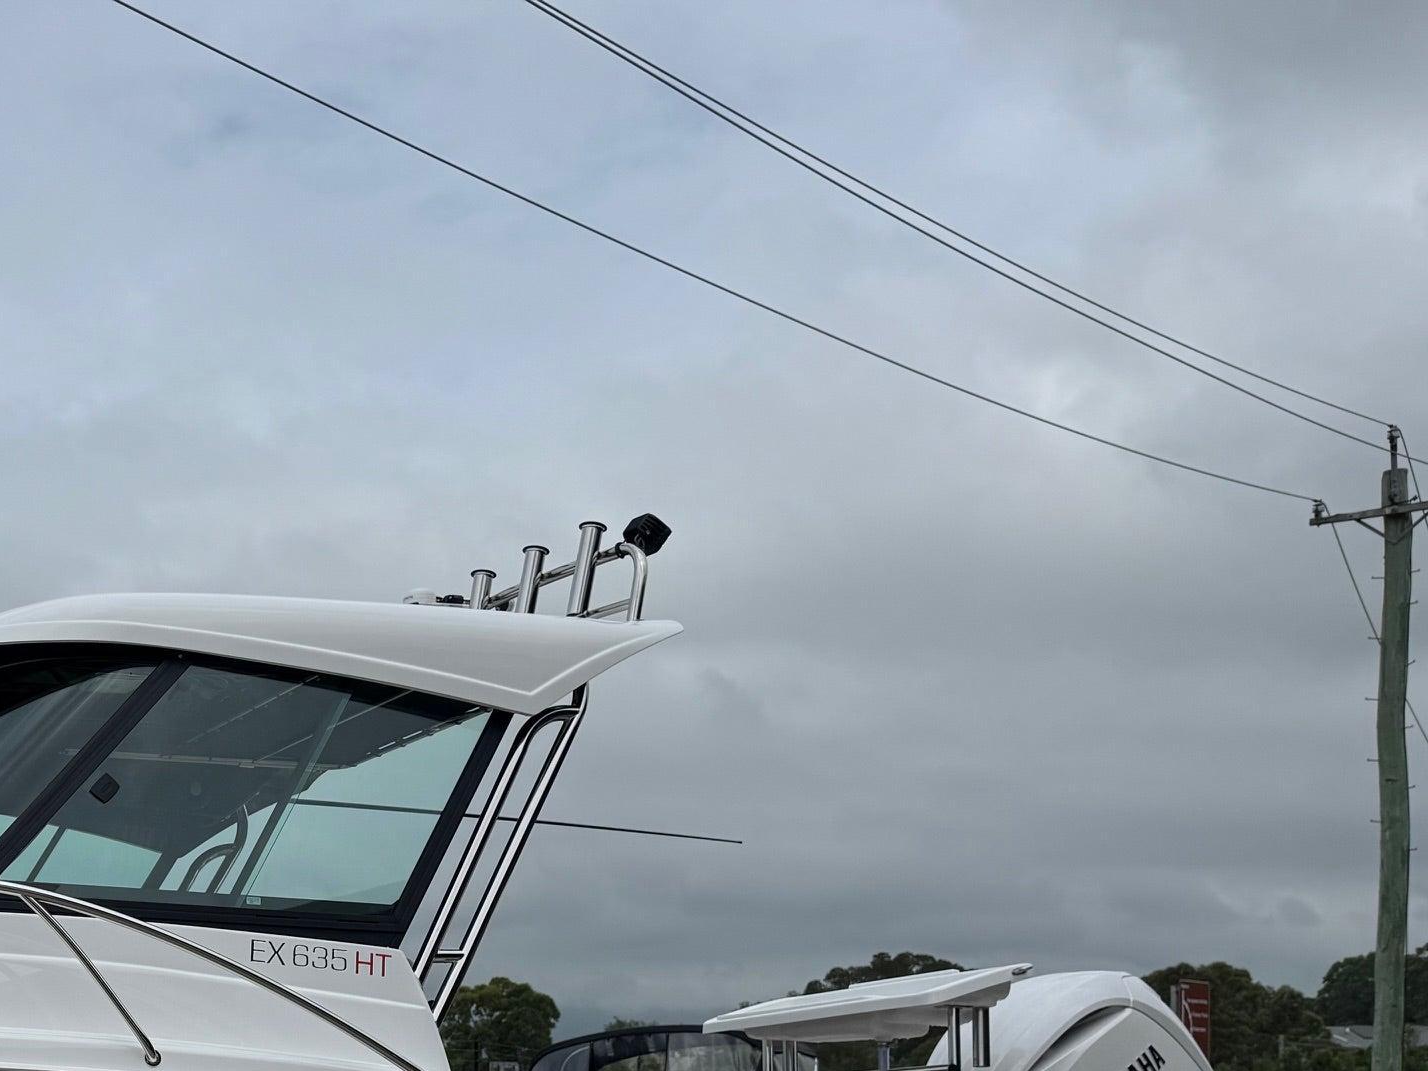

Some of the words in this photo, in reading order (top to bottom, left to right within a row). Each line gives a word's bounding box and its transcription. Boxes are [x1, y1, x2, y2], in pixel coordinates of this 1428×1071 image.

[250, 939, 286, 966] EX
[292, 944, 348, 972] 635
[355, 951, 392, 977] HT
